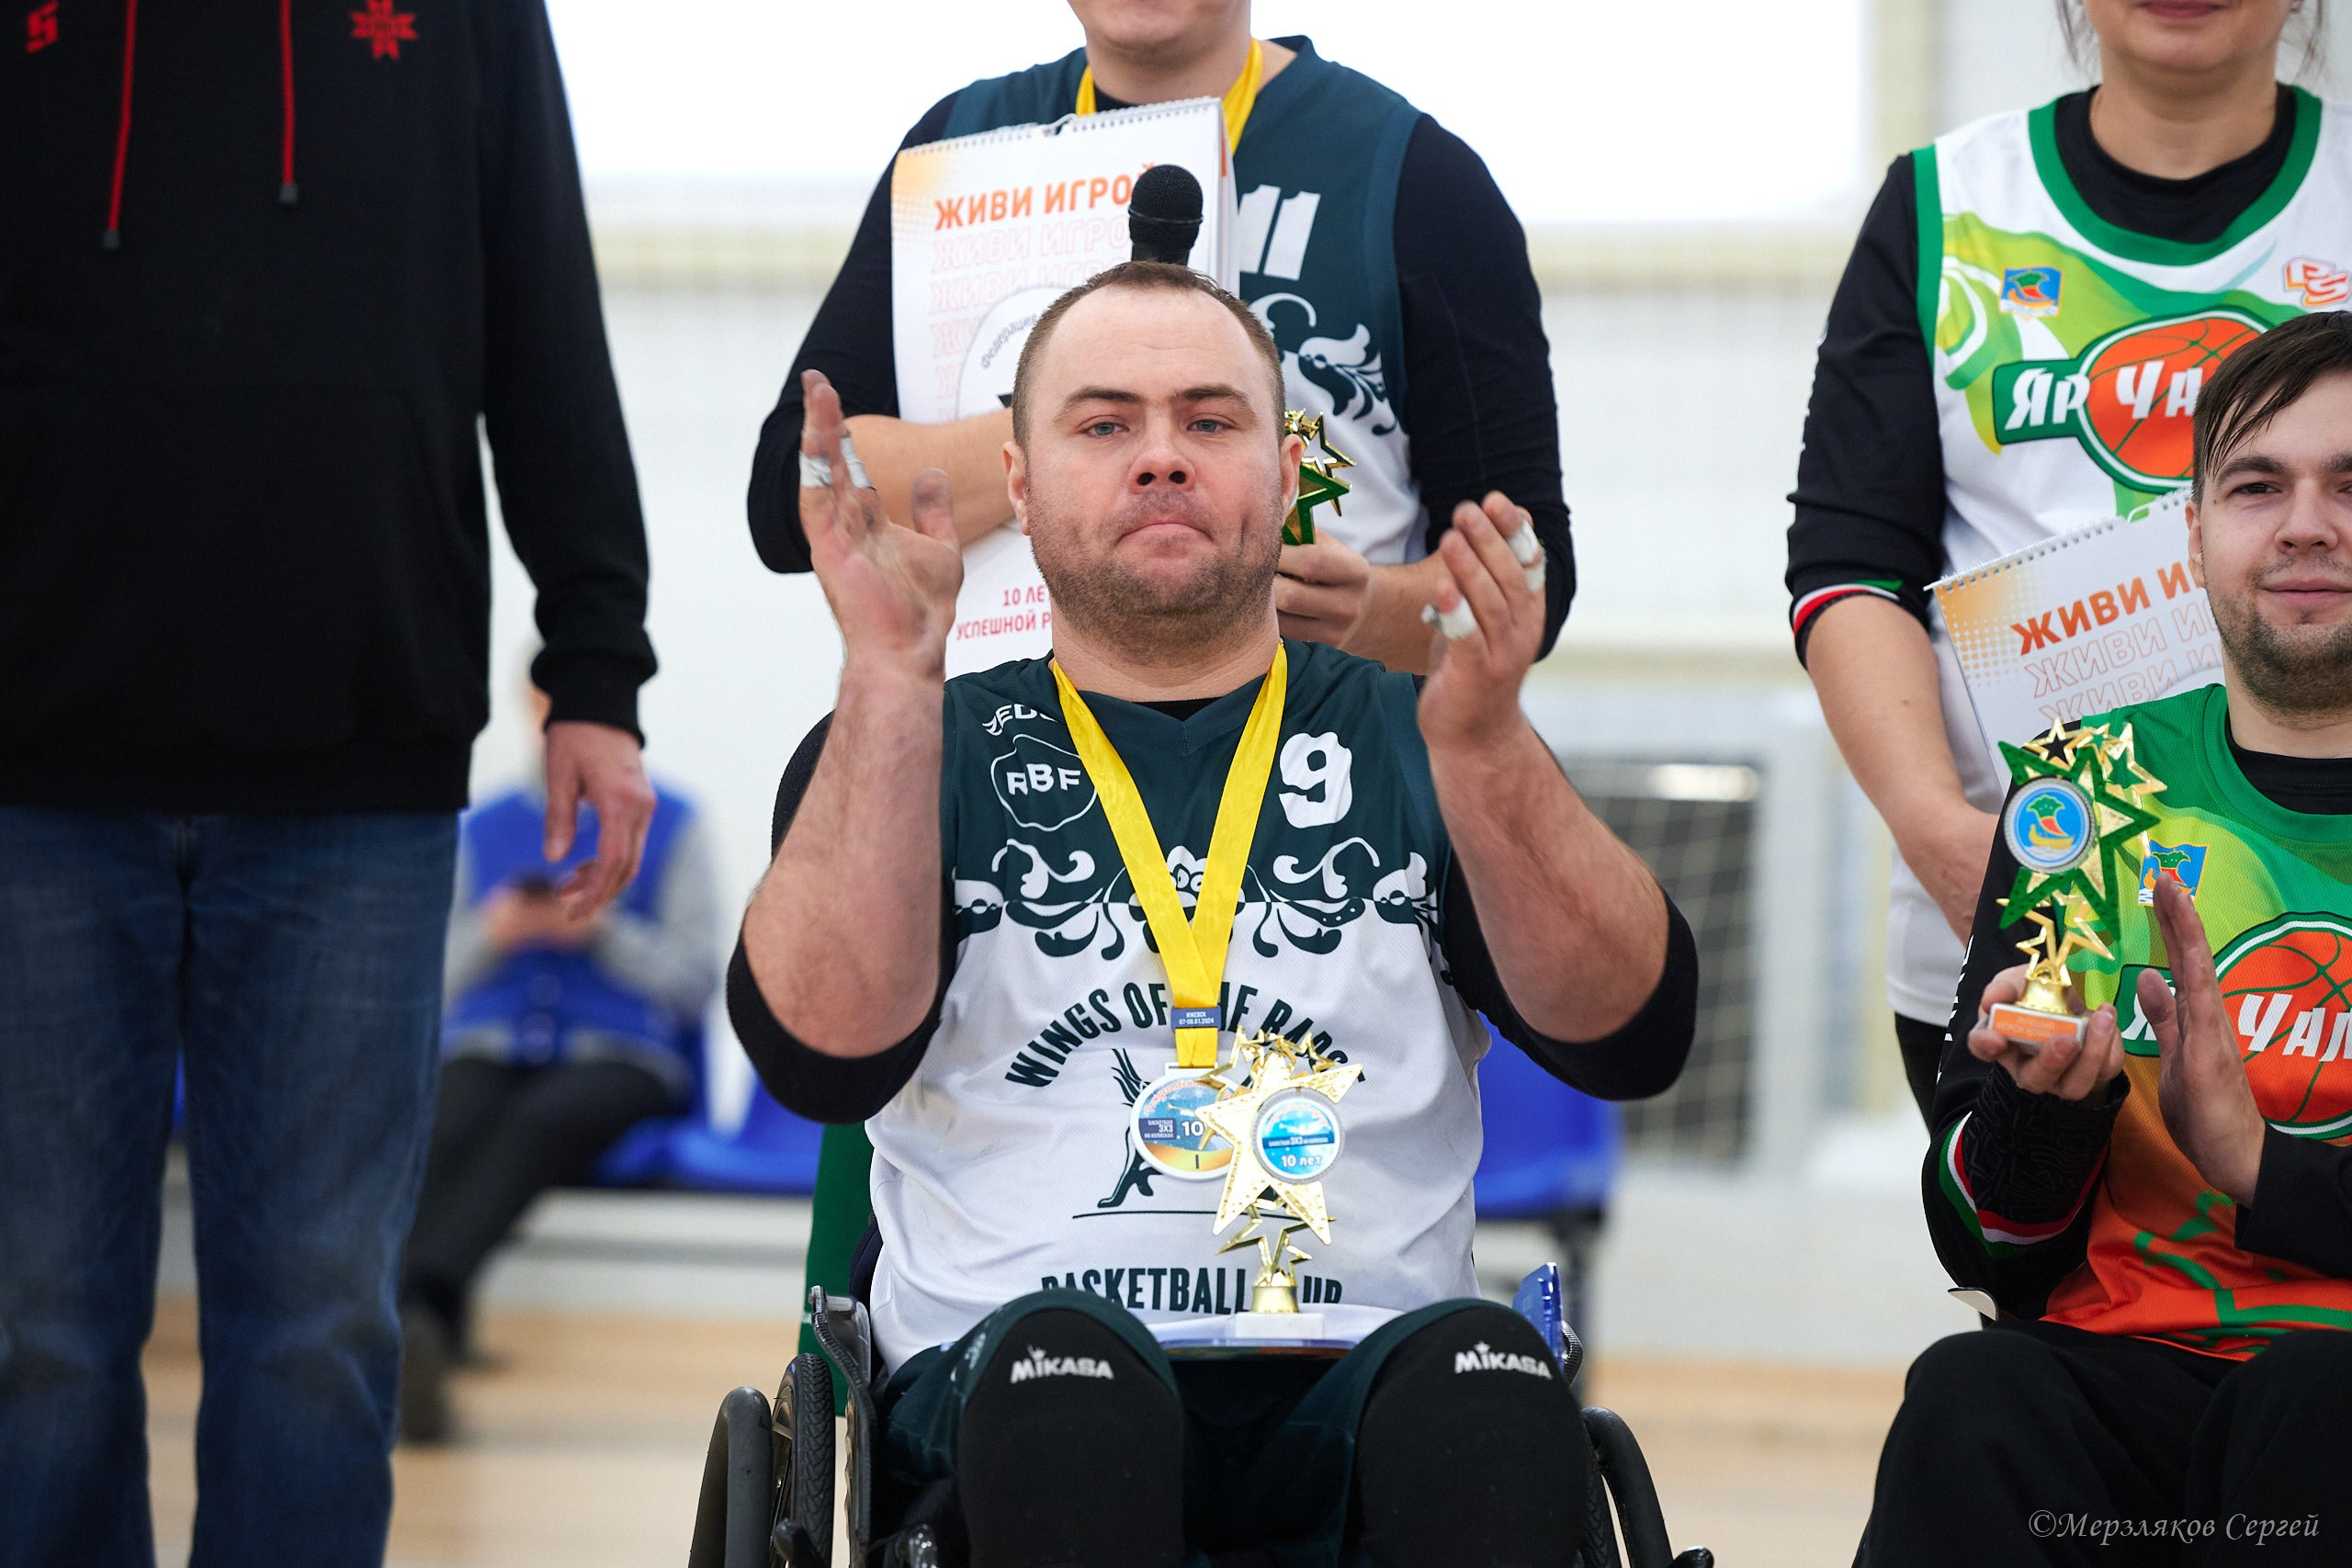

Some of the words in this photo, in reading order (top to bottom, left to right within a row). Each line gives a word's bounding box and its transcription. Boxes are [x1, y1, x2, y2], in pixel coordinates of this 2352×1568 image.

[934, 186, 1032, 231] ЖИВИ
[1044, 162, 1155, 214] ИГРО
[931, 226, 1031, 274] ЖИВИ
[1039, 215, 1130, 257] ИГРО
[1238, 185, 1321, 281] 11
[2005, 367, 2090, 431] ЯР
[2116, 360, 2202, 420] ЧА
[956, 609, 1037, 641] УСПЕШНОЙ
[1003, 588, 1021, 607] 10
[1025, 585, 1046, 604] ЛЕ
[2010, 577, 2151, 656] ЖИВИ
[2025, 617, 2168, 699] ЖИВИ
[1006, 763, 1081, 795] RBF
[1279, 731, 1352, 829] 9
[1004, 988, 1122, 1088] WINGS
[1123, 982, 1168, 1029] OF
[1182, 1120, 1204, 1137] 10
[1281, 1154, 1296, 1168] 10
[1299, 1156, 1322, 1167] лет
